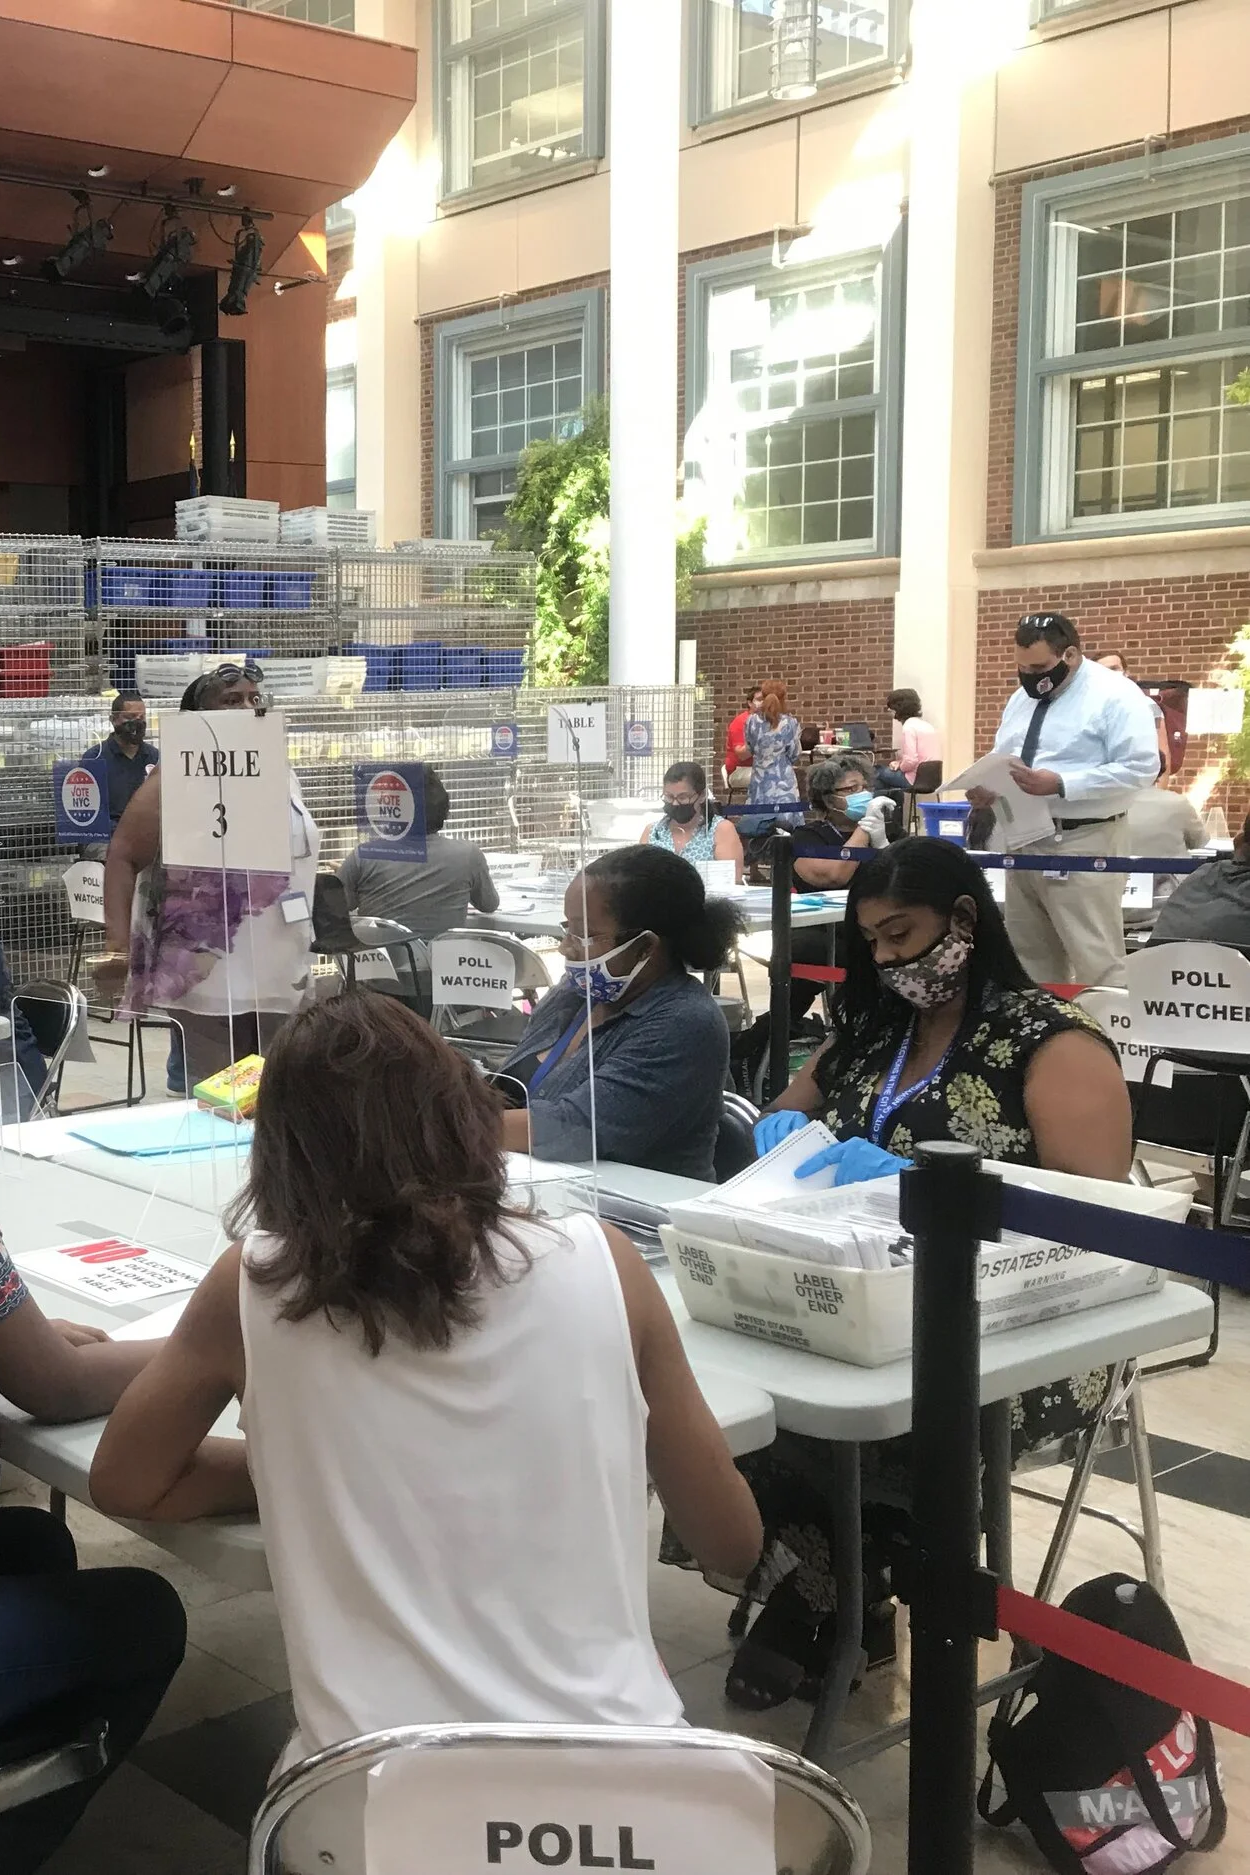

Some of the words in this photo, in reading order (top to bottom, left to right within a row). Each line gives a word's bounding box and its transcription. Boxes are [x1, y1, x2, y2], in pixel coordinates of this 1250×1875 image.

[558, 716, 595, 729] TABLE
[180, 750, 260, 777] TABLE
[71, 785, 89, 797] VOTE
[377, 791, 400, 806] VOTE
[72, 797, 90, 807] NYC
[212, 803, 228, 838] 3
[379, 807, 401, 818] NYC
[82, 876, 100, 887] POLL
[73, 893, 104, 905] WATCHE
[458, 956, 493, 969] POLL
[440, 976, 508, 990] WATCHER
[1171, 970, 1231, 988] POLL
[1110, 1015, 1131, 1029] PO
[873, 1113, 885, 1132] CITY
[56, 1239, 149, 1264] NO
[677, 1243, 714, 1264] LABEL
[680, 1256, 717, 1277] OTHER
[990, 1250, 1045, 1278] STATES
[105, 1267, 162, 1289] ALLOWED
[112, 1278, 137, 1288] THE
[124, 1264, 177, 1284] DEVICES
[689, 1270, 713, 1286] END
[794, 1272, 839, 1290] LABEL
[1023, 1270, 1067, 1289] WARNING
[78, 1276, 117, 1292] TABLE
[795, 1285, 844, 1303] OTHER
[808, 1300, 838, 1315] END
[734, 1312, 766, 1327] UNITED
[768, 1319, 803, 1336] STATES
[734, 1321, 770, 1337] POSTAL
[772, 1330, 810, 1347] SERVICE
[486, 1821, 655, 1870] POLL
